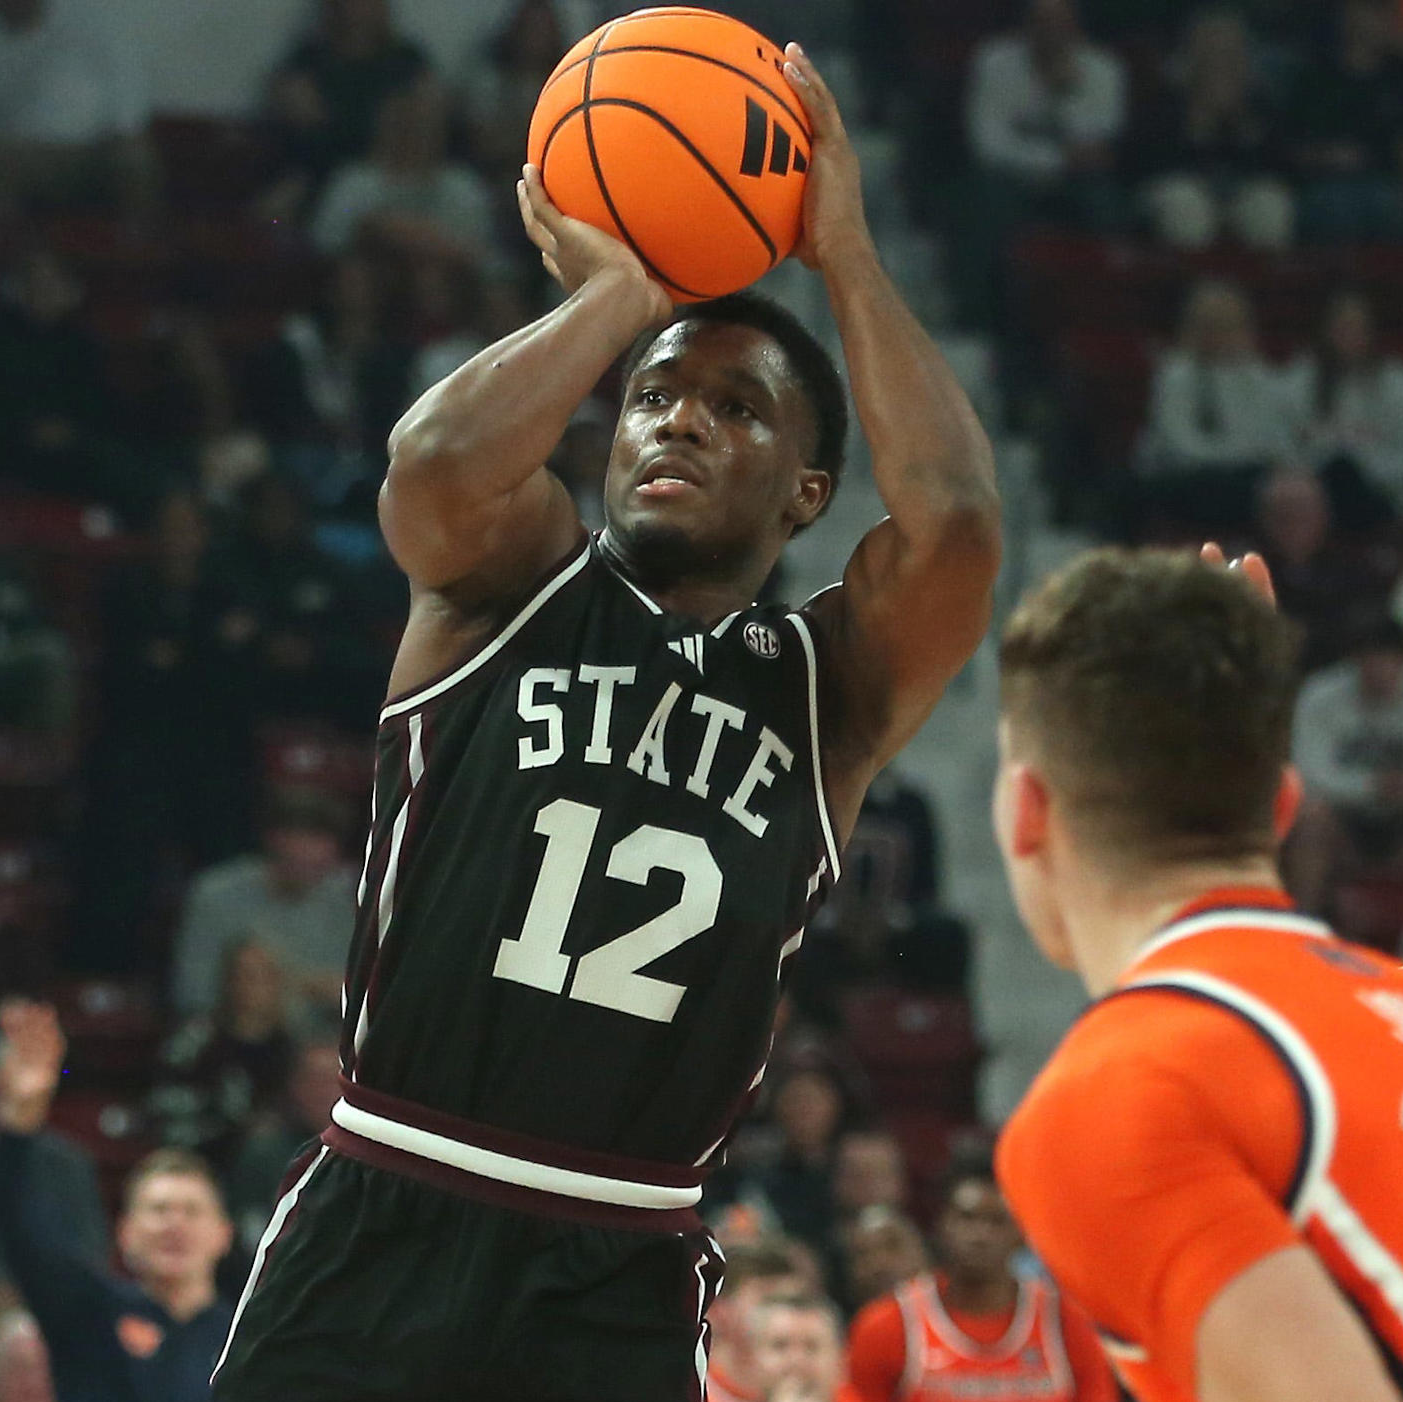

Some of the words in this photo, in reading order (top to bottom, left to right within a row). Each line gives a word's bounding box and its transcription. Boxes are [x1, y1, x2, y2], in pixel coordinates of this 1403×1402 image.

[746, 624, 779, 657] SEC
[516, 663, 795, 838] STATE
[493, 798, 724, 1024] 12
